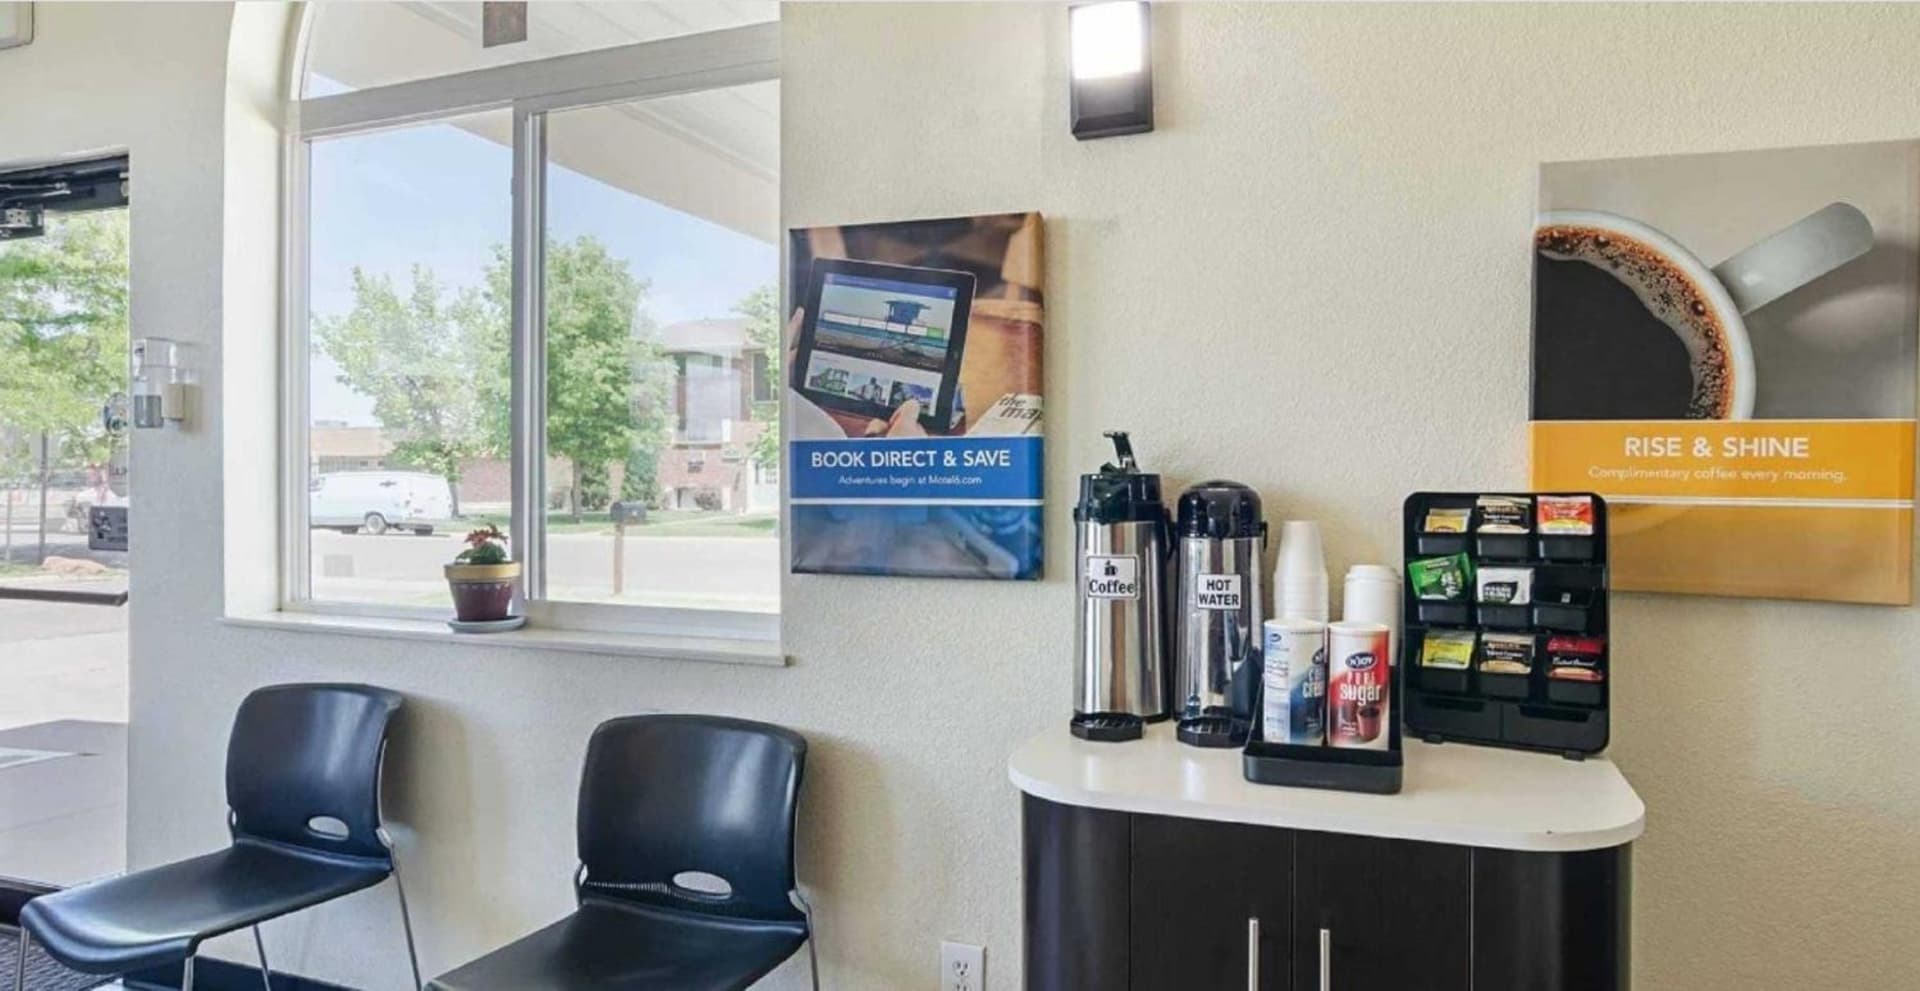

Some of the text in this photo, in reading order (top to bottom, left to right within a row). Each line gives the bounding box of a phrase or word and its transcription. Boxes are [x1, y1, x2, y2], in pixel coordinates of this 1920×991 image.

[998, 393, 1026, 407] the
[1624, 436, 1810, 459] RISE & SHINE
[811, 449, 1011, 467] BOOK DIRECT & SAVE
[838, 474, 982, 487] Adventures begin at Motel6.com
[1588, 465, 1847, 483] Complimentary coffee every morning.
[1089, 579, 1135, 594] Coffee
[1206, 579, 1231, 591] HOT
[1199, 593, 1240, 606] WATER
[1340, 682, 1382, 706] sugar
